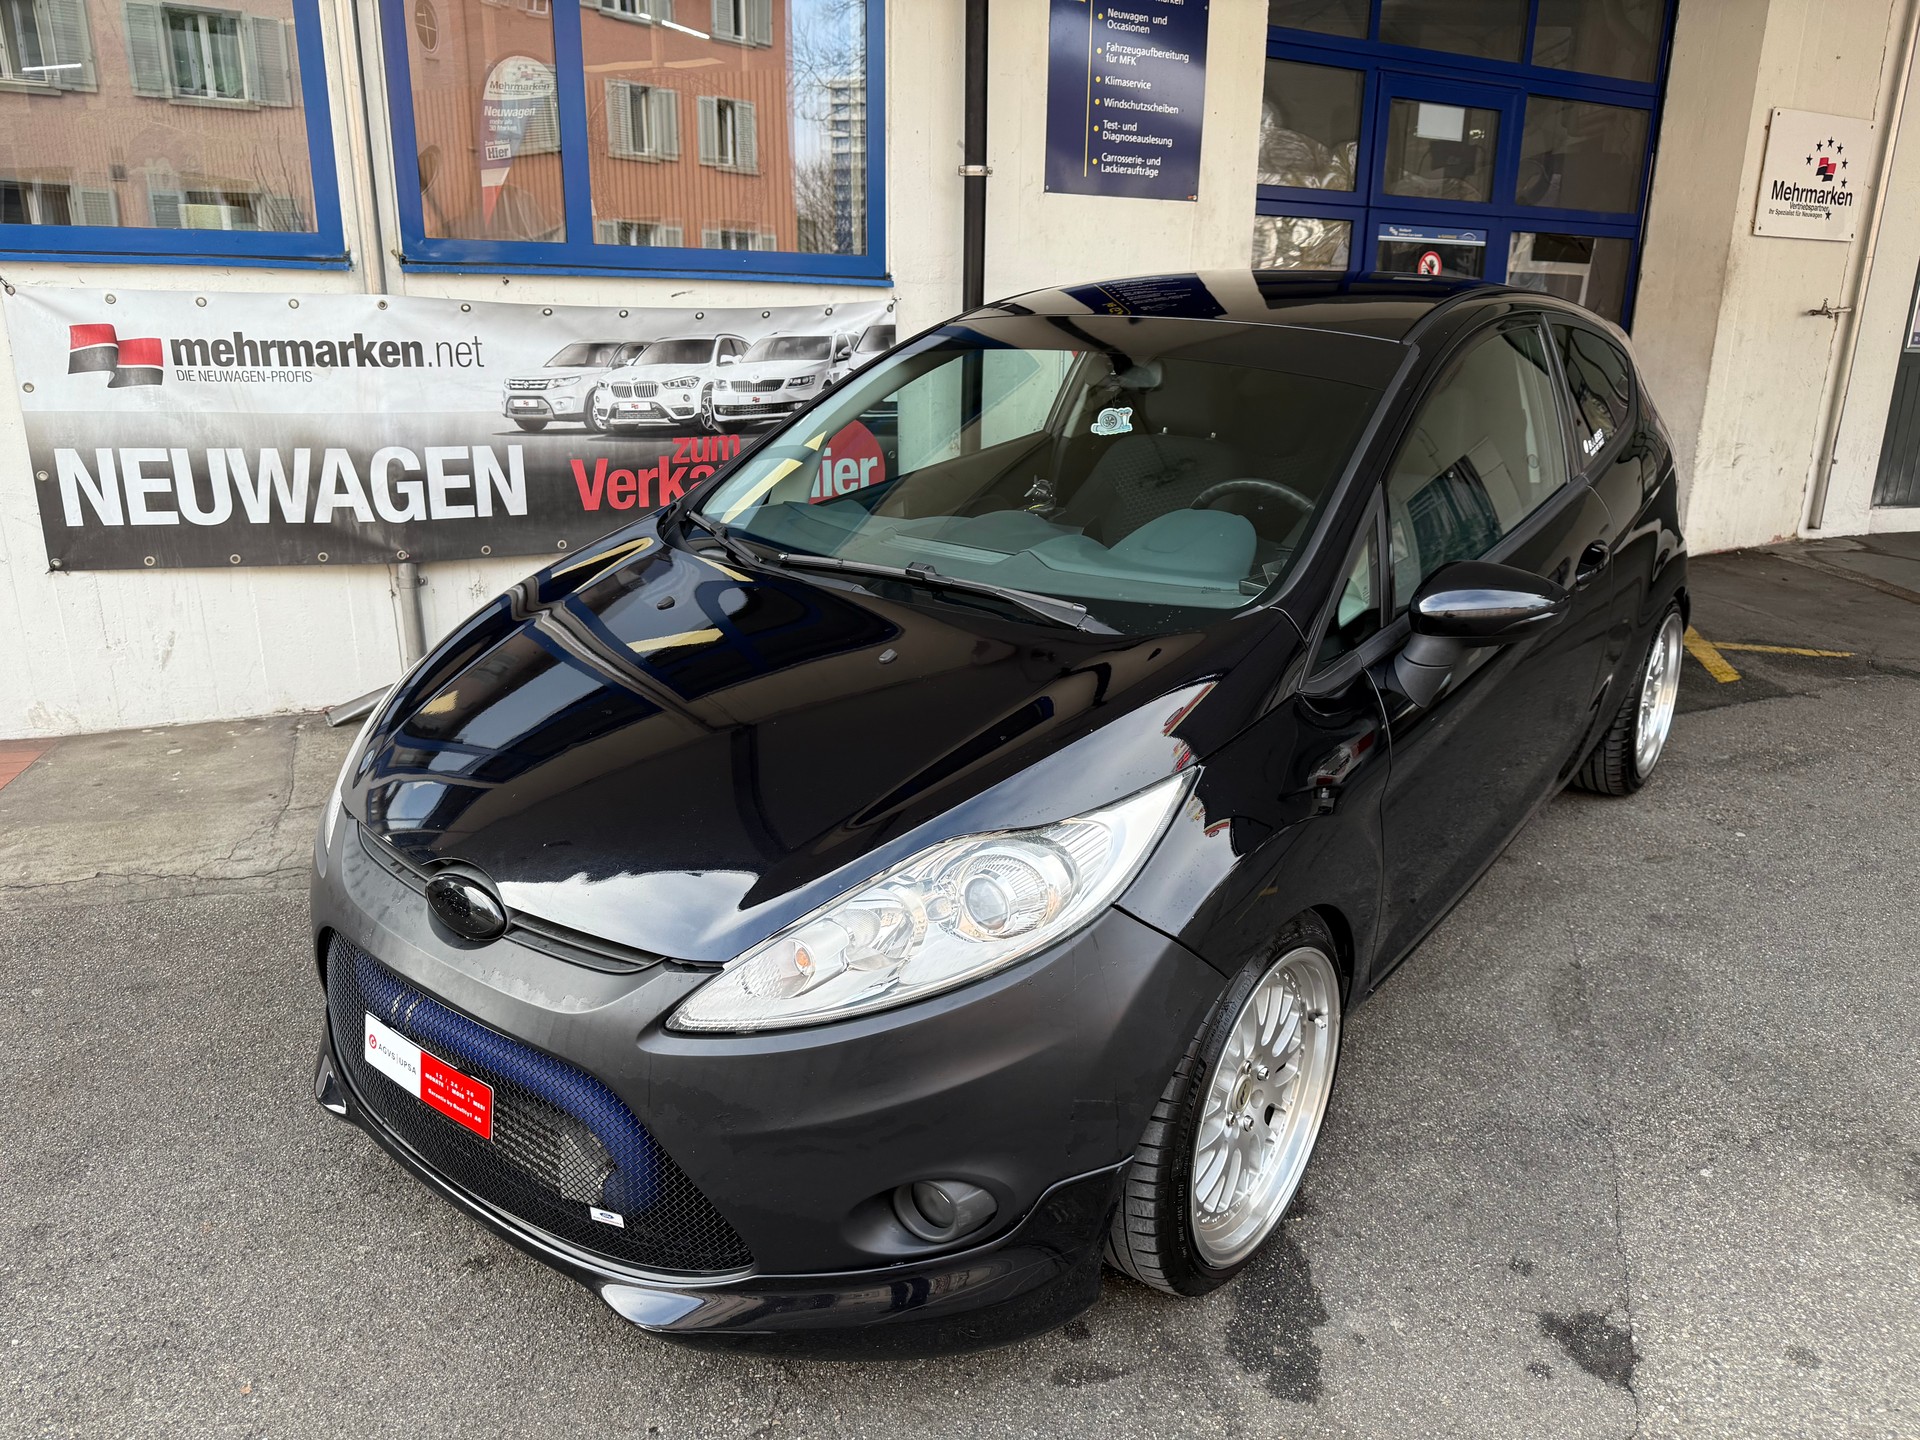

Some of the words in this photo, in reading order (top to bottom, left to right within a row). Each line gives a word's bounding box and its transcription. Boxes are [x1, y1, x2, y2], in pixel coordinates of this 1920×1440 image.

[1107, 8, 1149, 23] Neuwagen
[1152, 16, 1168, 26] und
[1106, 20, 1150, 34] Occasionen
[1105, 42, 1190, 63] Fahrzeugaufbereitung
[1105, 53, 1118, 63] für
[1119, 55, 1137, 66] MFK
[489, 80, 550, 91] Mehrmarken
[1104, 76, 1151, 90] Klimaservice
[483, 106, 536, 119] Neuwagen
[1103, 97, 1179, 114] Windschutzscheiben
[1103, 120, 1121, 131] Test-
[1122, 122, 1138, 132] und
[1102, 131, 1173, 147] Diagnoseauslesung
[487, 147, 510, 159] Hier
[1101, 152, 1145, 165] Carrosserie-
[1146, 156, 1161, 166] und
[1101, 163, 1159, 178] Lackieraufträge
[1771, 180, 1853, 207] Mehrmarken
[1775, 209, 1795, 217] Spezialist
[1801, 211, 1823, 219] Neuwagen
[1789, 202, 1829, 213] Vertriebspartner
[170, 331, 485, 369] mehrmarken.net
[176, 369, 196, 382] DIE
[198, 370, 313, 383] NEUWAGEN-PROFIS
[672, 434, 740, 464] zum
[53, 444, 529, 528] NEUWAGEN
